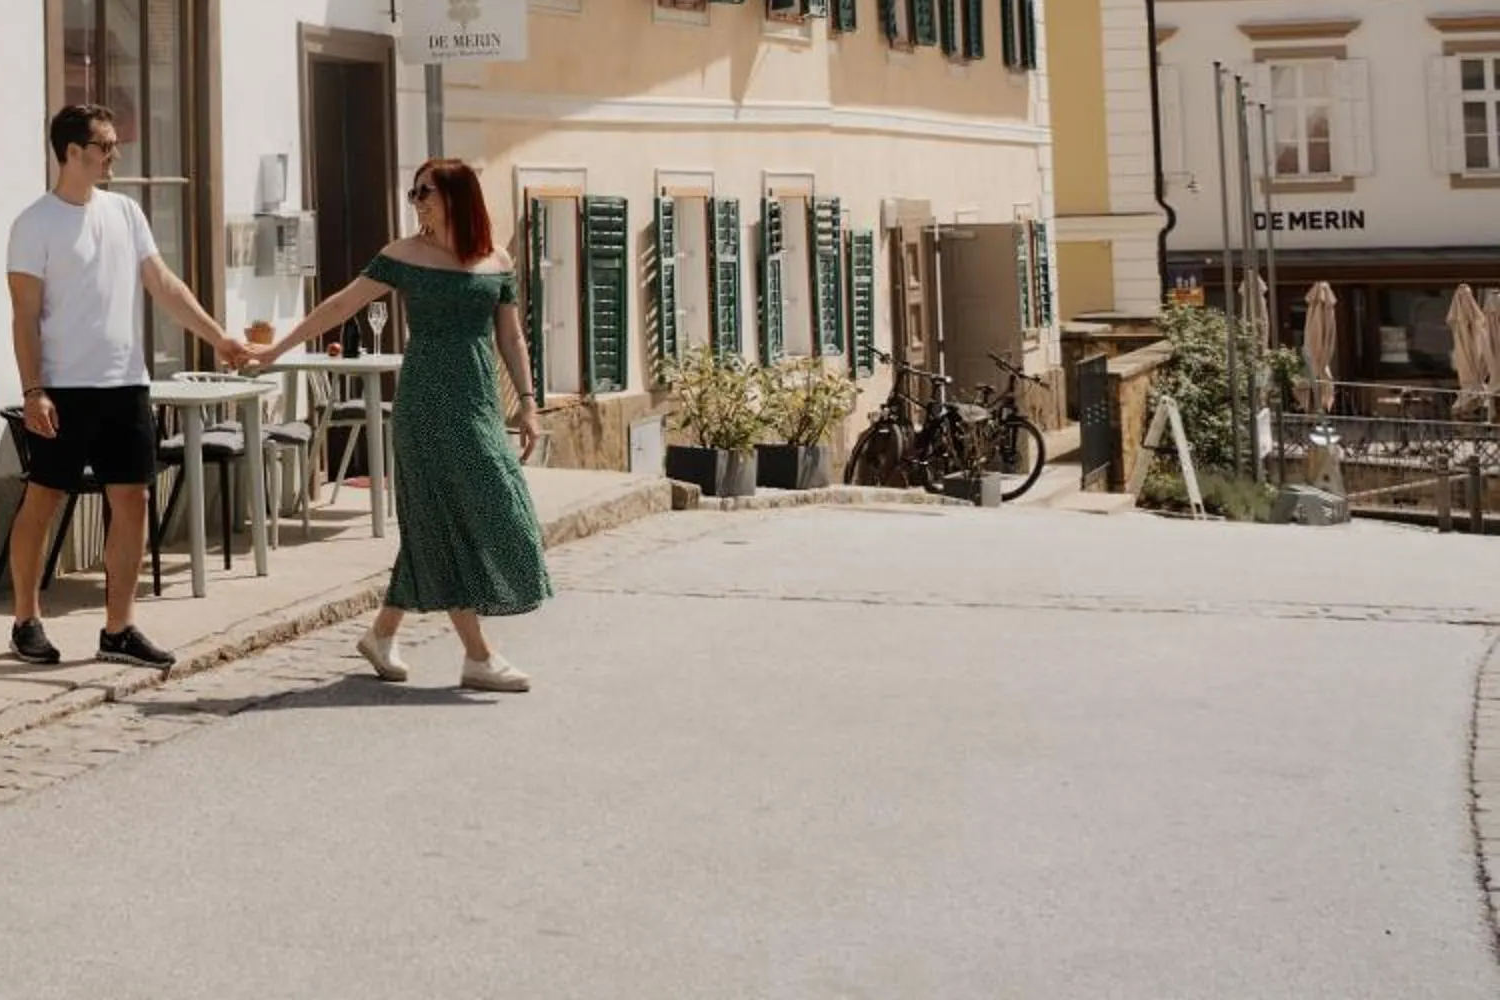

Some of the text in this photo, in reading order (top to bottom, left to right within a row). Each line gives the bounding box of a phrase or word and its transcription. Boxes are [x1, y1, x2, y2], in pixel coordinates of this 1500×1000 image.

[428, 32, 501, 49] DE MERIN
[1253, 210, 1365, 230] DE MERIN
